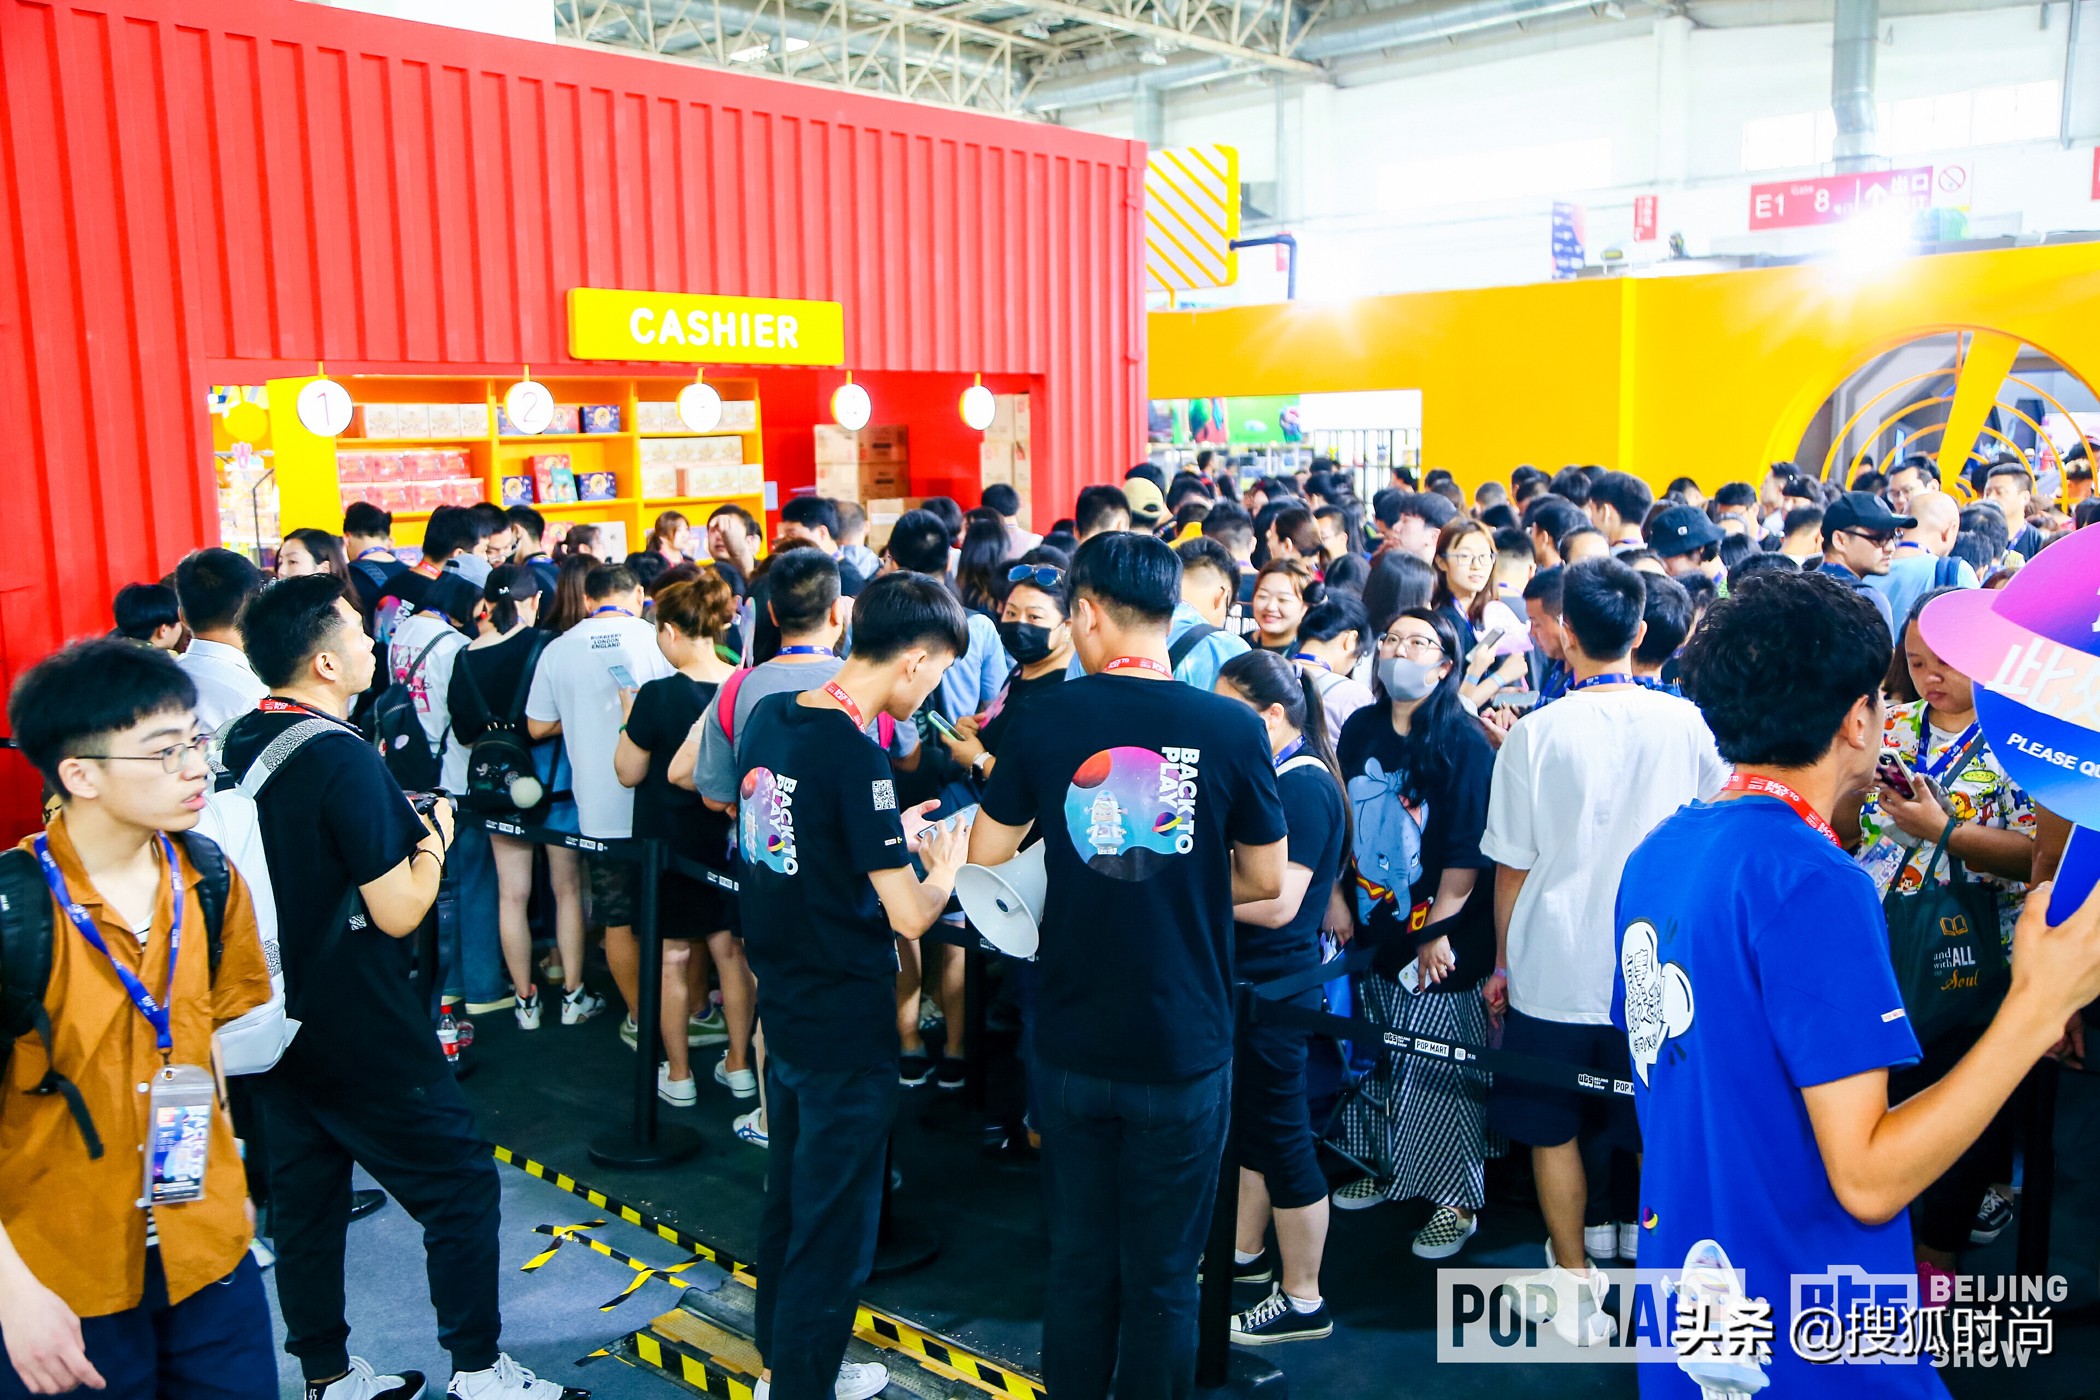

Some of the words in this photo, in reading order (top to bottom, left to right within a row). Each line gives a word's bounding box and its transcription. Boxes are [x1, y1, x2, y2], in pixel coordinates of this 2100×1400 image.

[1755, 193, 1785, 218] E1
[1814, 188, 1830, 213] 8
[630, 307, 799, 349] CASHIER
[316, 392, 331, 427] 1
[521, 391, 539, 423] 2
[2006, 733, 2078, 770] PLEASE
[1158, 746, 1182, 809] PLAY
[1177, 747, 1200, 819] BACK
[1766, 780, 1790, 794] BACK
[1789, 791, 1800, 802] TO
[769, 773, 786, 833] PLAY
[780, 777, 798, 841] BACK
[1175, 819, 1195, 855] TO
[782, 844, 799, 876] TO
[1933, 959, 1953, 969] with
[1953, 946, 1976, 967] ALL
[1940, 968, 1980, 990] Soul
[1416, 1040, 1428, 1050] POP
[1429, 1043, 1447, 1055] MART
[1615, 1081, 1630, 1092] POP
